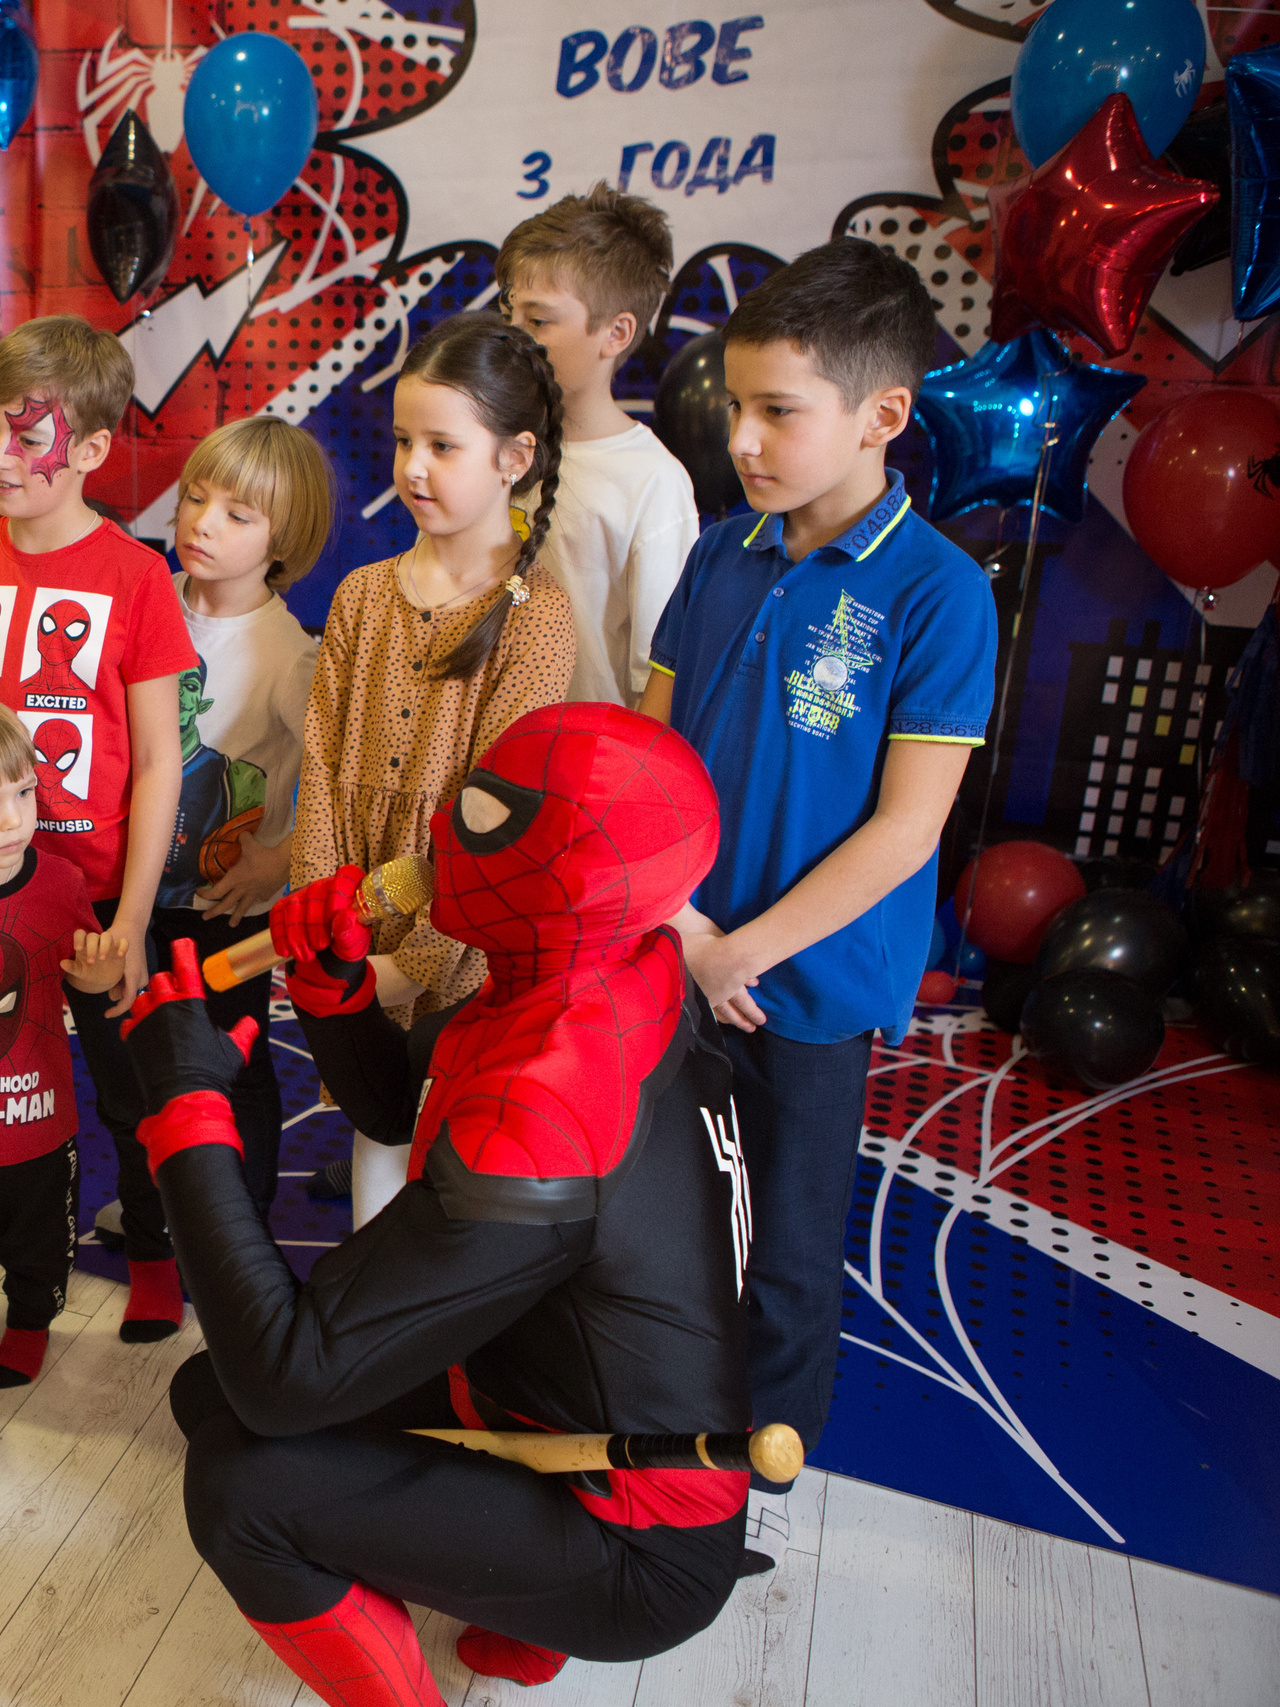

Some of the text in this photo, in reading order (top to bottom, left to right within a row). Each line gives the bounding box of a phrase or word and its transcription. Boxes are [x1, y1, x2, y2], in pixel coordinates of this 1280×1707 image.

[556, 15, 764, 99] ВОВЕ
[517, 134, 776, 199] 3 ГОДА
[26, 695, 87, 710] EXCITED
[35, 819, 93, 833] NFUSED
